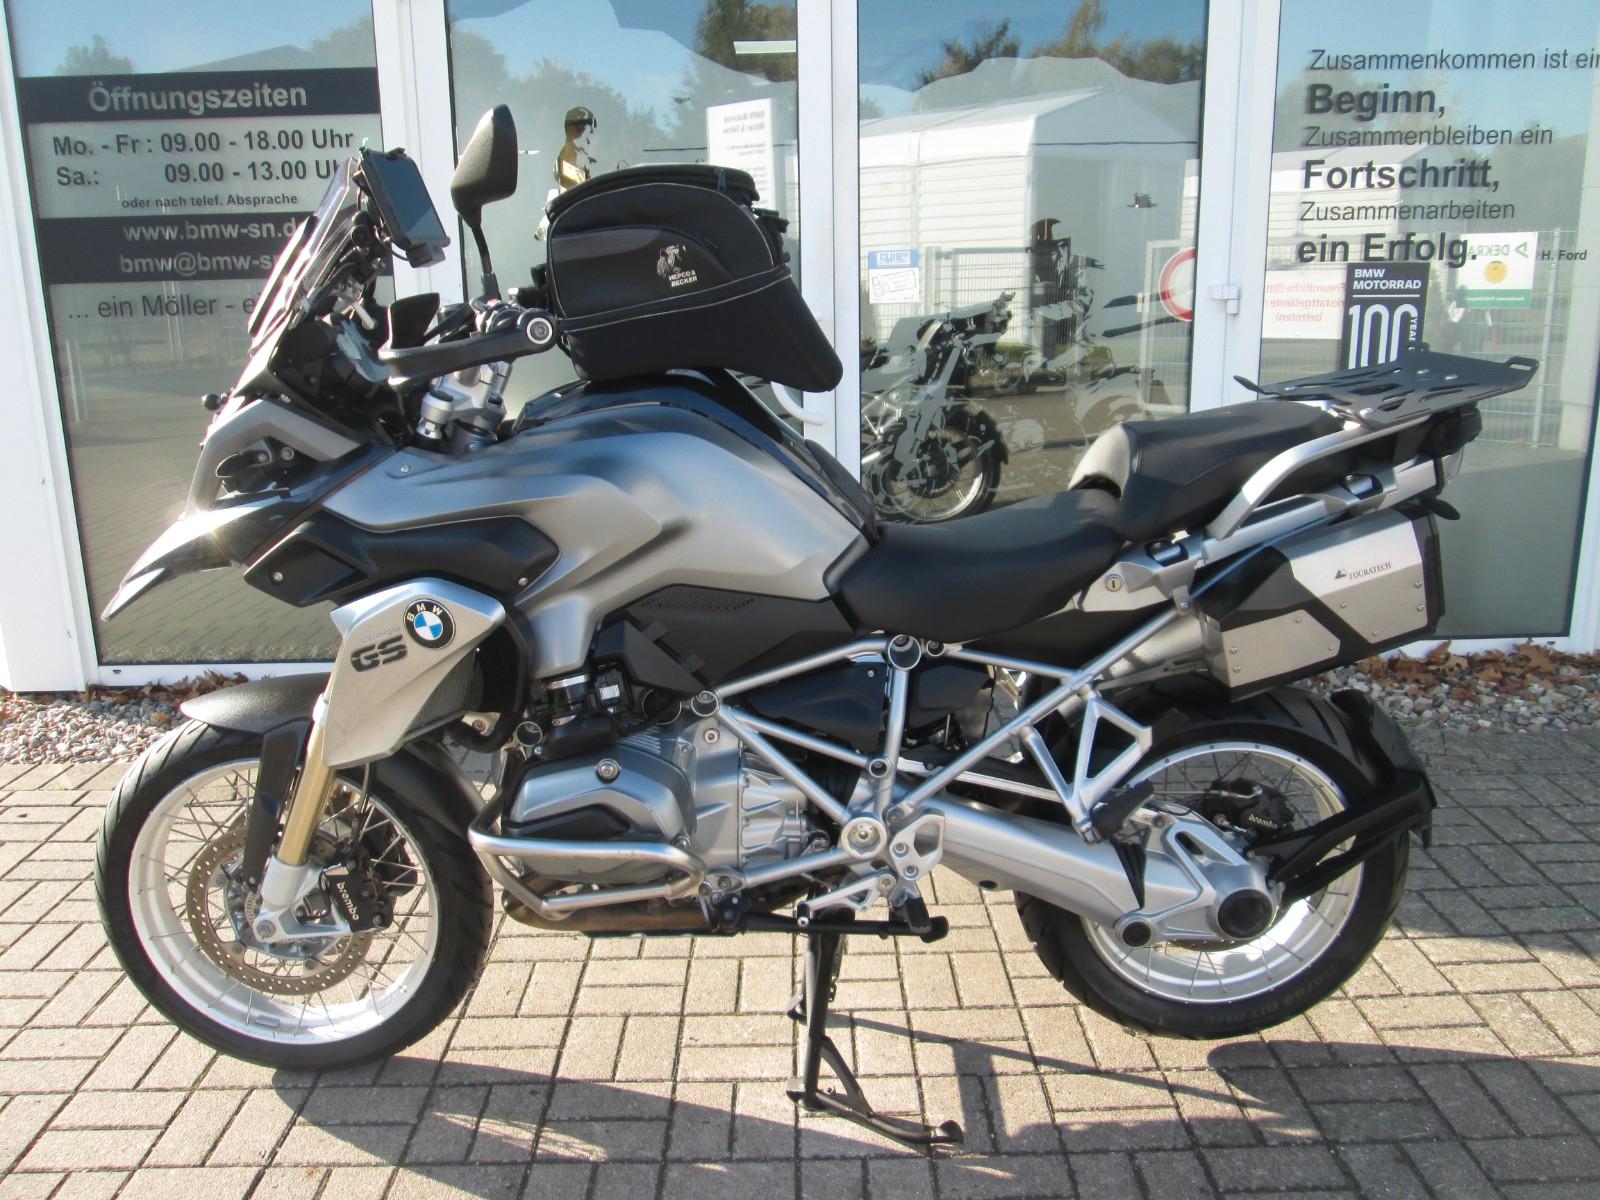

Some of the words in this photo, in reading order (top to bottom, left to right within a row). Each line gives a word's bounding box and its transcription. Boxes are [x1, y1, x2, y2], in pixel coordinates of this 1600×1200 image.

[1308, 48, 1536, 71] Zusammenkommen
[1543, 47, 1569, 69] ist
[88, 80, 308, 115] Öffnungszeiten
[1308, 82, 1446, 122] Beginn,
[53, 135, 94, 156] Mo.
[160, 131, 221, 153] 09.00
[244, 129, 304, 151] 18.00
[311, 128, 355, 149] Uhr
[1304, 124, 1513, 147] Zusammenbleiben
[1520, 124, 1553, 145] ein
[56, 166, 100, 186] Sa.:
[164, 162, 224, 184] 09.00
[247, 159, 307, 182] 13.00
[1303, 157, 1500, 192] Fortschritt,
[121, 197, 151, 209] oder
[156, 195, 188, 208] nach
[190, 194, 224, 207] telef.
[226, 192, 298, 209] Absprache
[1299, 199, 1516, 222] Zusammenarbeiten
[123, 217, 297, 242] www.bmw-sn.d
[1297, 233, 1350, 263] ein
[1363, 232, 1478, 268] Erfolg.
[1541, 249, 1555, 261] H.
[1558, 249, 1588, 261] Ford
[669, 270, 691, 281] HEPCO
[671, 275, 698, 287] BECKER
[1353, 279, 1422, 290] MOTORRAD
[1354, 268, 1386, 278] BMW
[97, 296, 135, 319] ein
[143, 294, 217, 319] Möller
[1349, 562, 1392, 579] TOURATECH
[406, 602, 443, 622] BMW
[350, 634, 409, 673] GS
[336, 881, 360, 921] brembo
